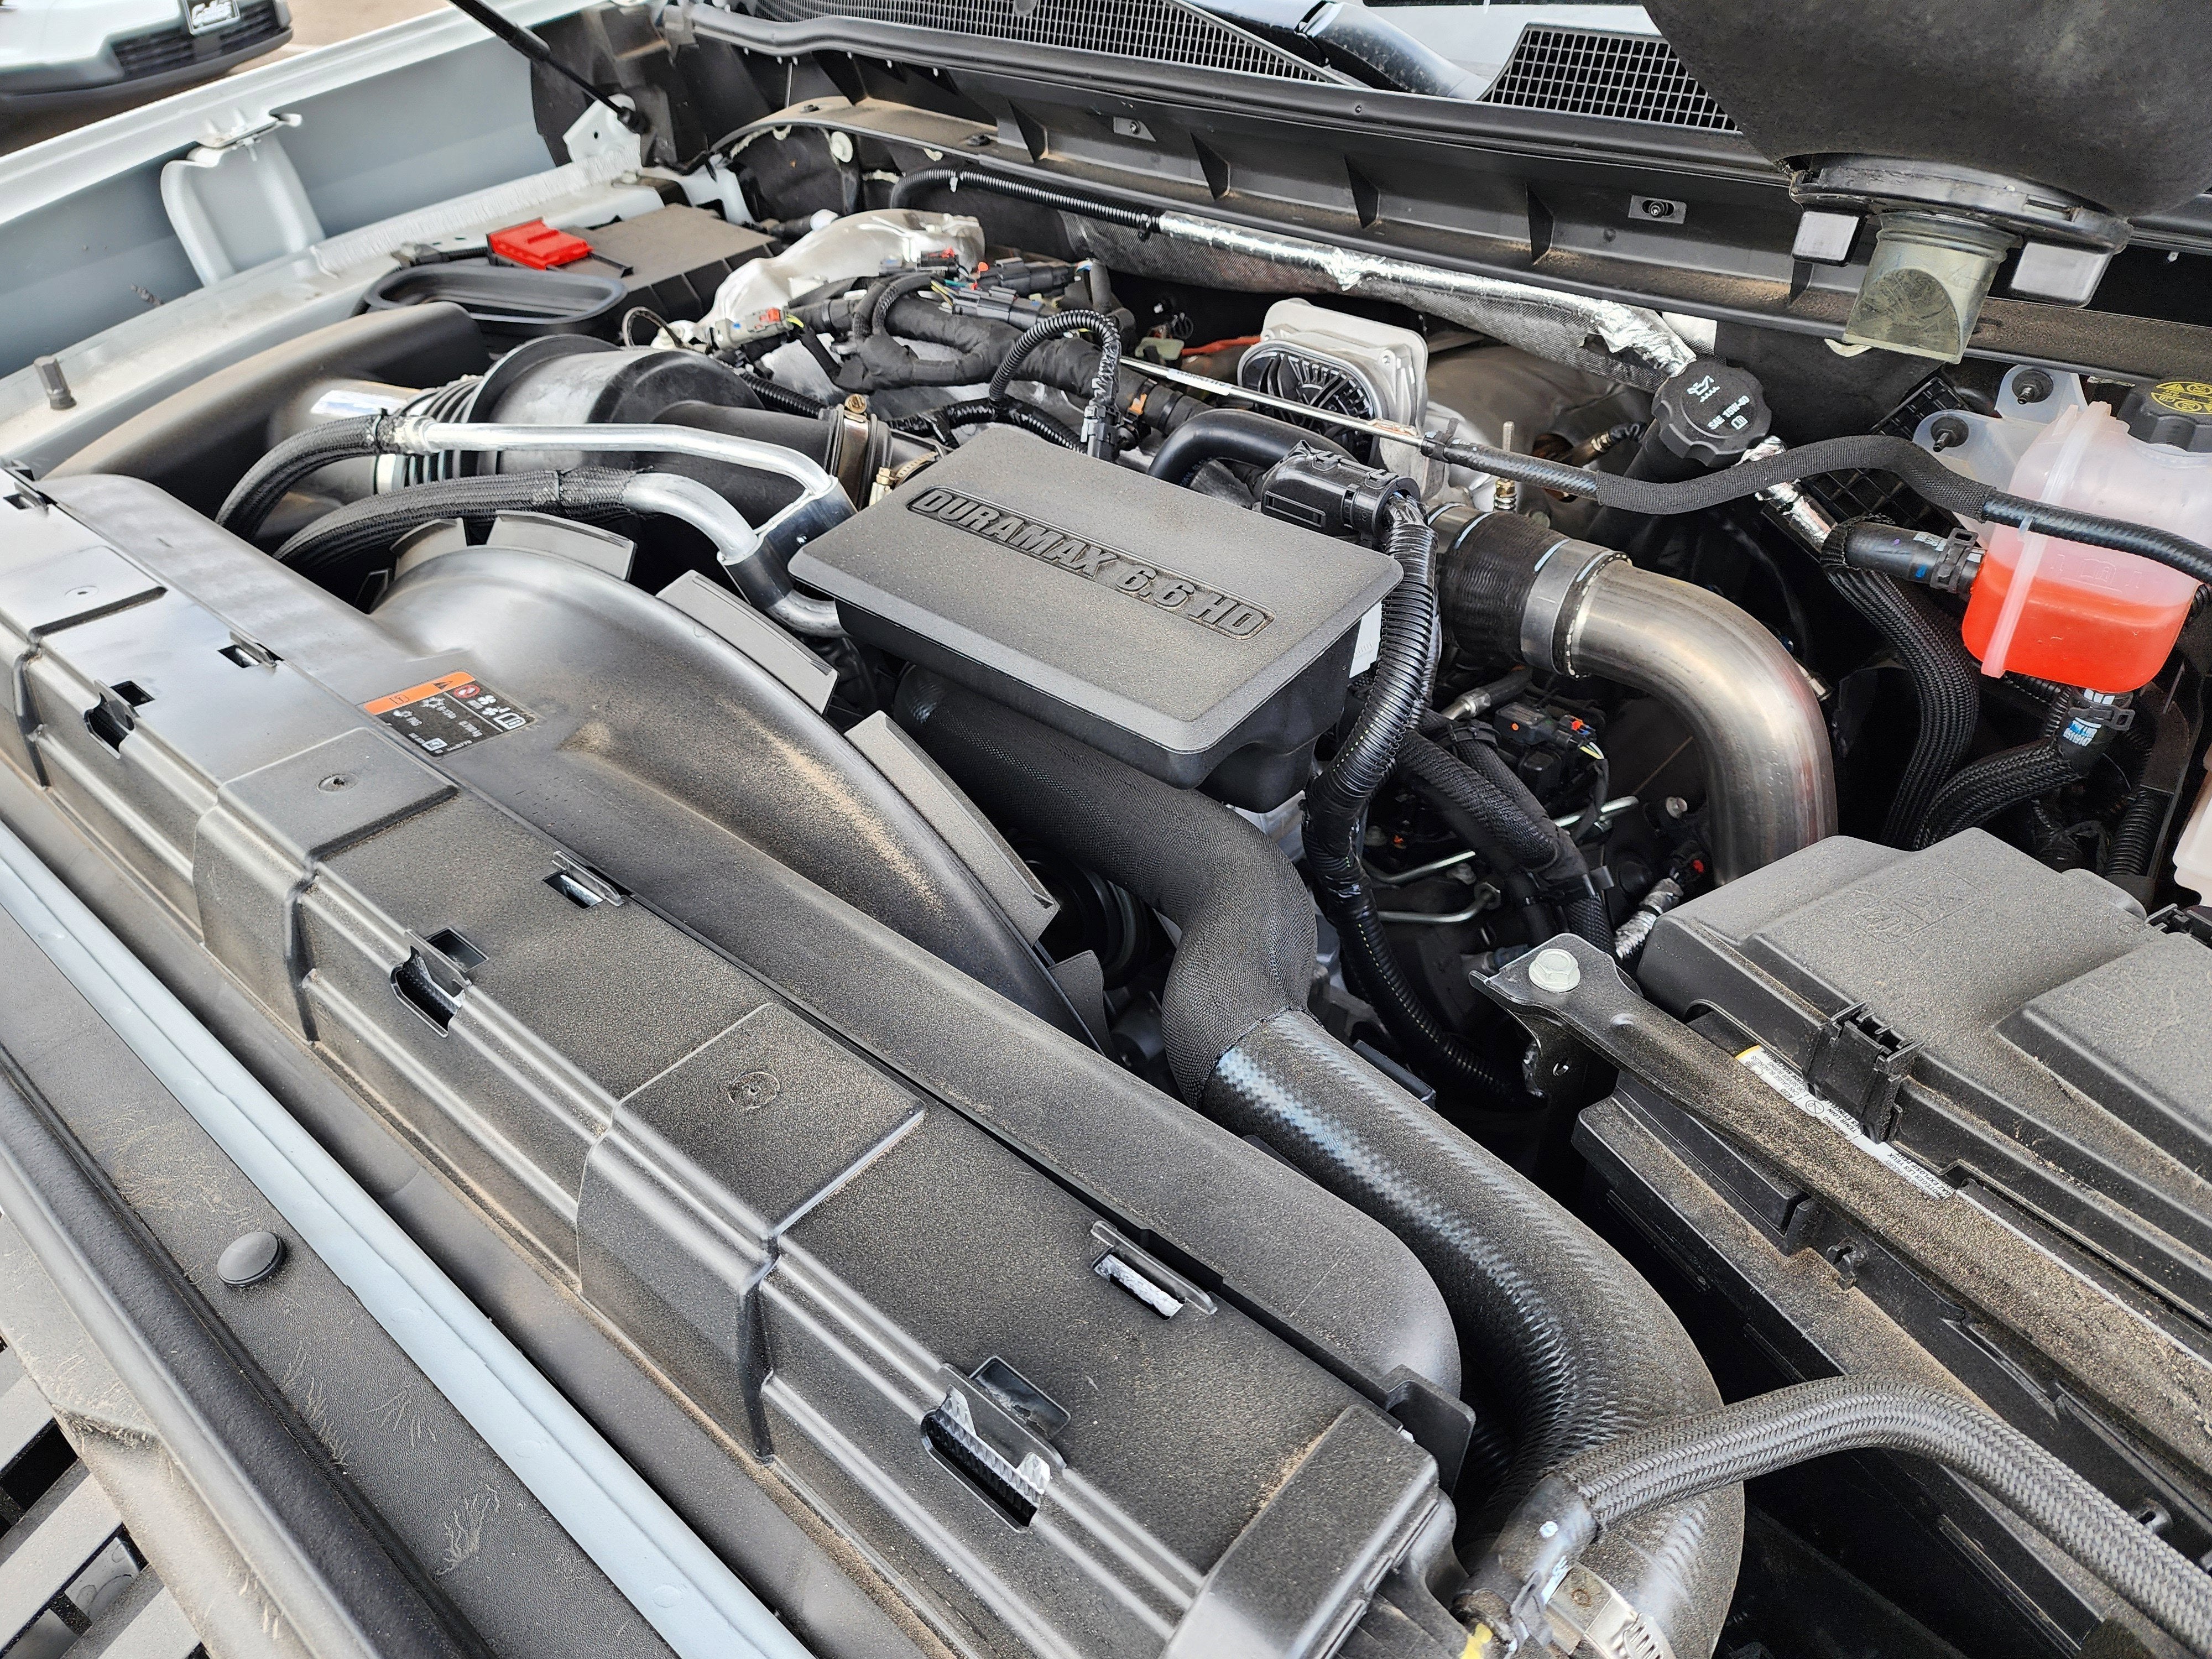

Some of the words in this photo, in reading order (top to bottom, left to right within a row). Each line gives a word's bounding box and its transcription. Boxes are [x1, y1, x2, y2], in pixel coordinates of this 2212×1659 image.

[1707, 415, 1725, 430] SAE
[1722, 395, 1750, 418] 15W-40
[913, 490, 1118, 578] DURAMAX
[1115, 564, 1196, 607] 6.6
[1188, 592, 1266, 638] HD
[1750, 1055, 1775, 1075] BLINDNESS
[1767, 1061, 1784, 1074] BURNS
[1772, 1073, 1790, 1087] CAUSE
[1780, 1088, 1794, 1098] ACID
[1788, 1086, 1799, 1095] CAN
[1826, 1108, 1840, 1119] LOIN
[1839, 1118, 1856, 1133] TENIR
[1886, 1152, 1904, 1166] YEUX
[1883, 1159, 1903, 1174] INJURY
[1903, 1165, 1916, 1175] LES
[1911, 1164, 1938, 1186] EXPLOSIF
[1937, 1185, 1951, 1196] GAZ
